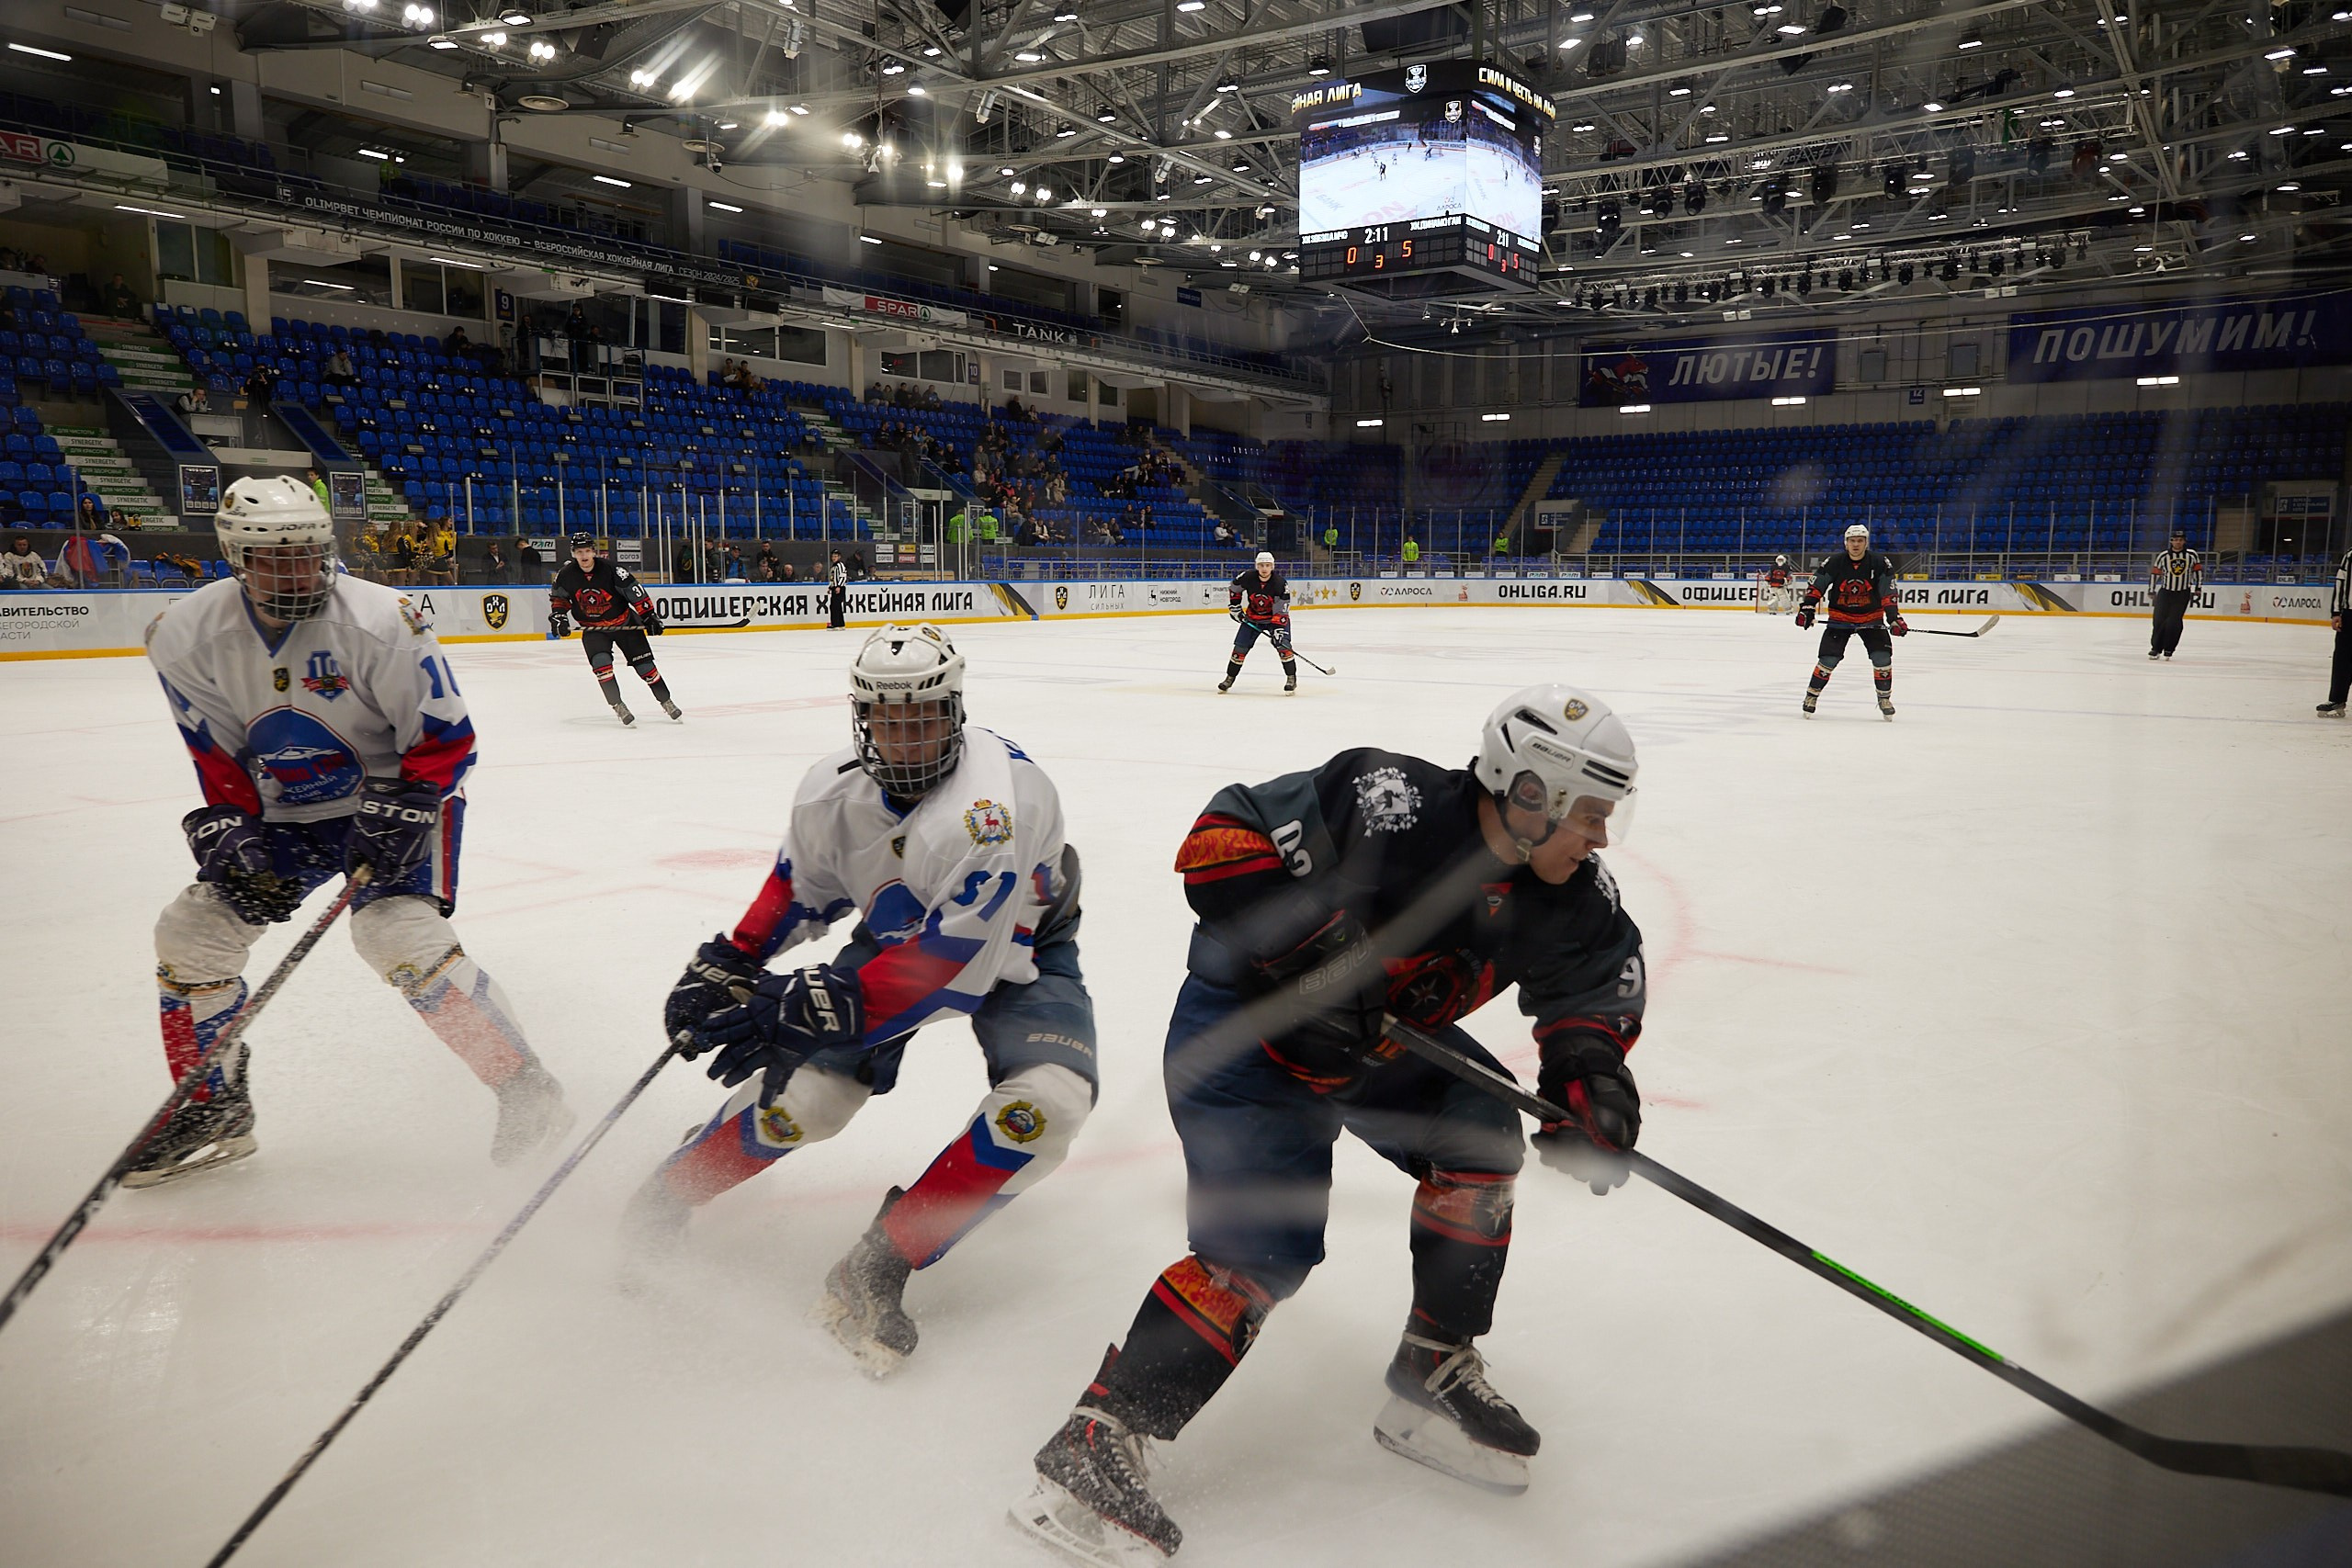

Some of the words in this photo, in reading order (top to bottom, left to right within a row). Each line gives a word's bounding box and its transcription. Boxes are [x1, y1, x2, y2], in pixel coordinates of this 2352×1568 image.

[1327, 82, 1363, 104] ЛИГА
[1478, 67, 1505, 89] СИЛА
[1505, 77, 1512, 92] И
[1512, 84, 1532, 106] ЧЕСТЬ
[1533, 95, 1544, 111] НА
[305, 197, 360, 216] OLIMPBET
[362, 209, 424, 230] ЧЕМПИОНАТ
[426, 220, 465, 237] РОССИИ
[467, 228, 481, 239] ПО
[483, 231, 521, 246] ХОККЕЮ
[534, 240, 605, 261] ВСЕРОССИЙСКАЯ
[606, 252, 653, 270] ХОККЕЙНАЯ
[654, 262, 674, 274] ЛИГА
[679, 266, 703, 278] СЕЗОН
[1364, 226, 1389, 244] 2:11
[1347, 246, 1358, 265] 0
[1401, 240, 1413, 258] 5
[1488, 243, 1495, 261] 0
[1374, 254, 1385, 269] 3
[1500, 258, 1507, 273] 3
[1512, 253, 1520, 269] 5
[502, 295, 510, 310] 9
[876, 300, 919, 318] SPAR
[1012, 323, 1066, 344] TANK
[2032, 310, 2317, 364] ПОШУМИМ!
[969, 365, 978, 377] 10
[1668, 346, 1824, 387] ЛЮТЫЕ!
[71, 438, 103, 446] SYNERGETIC
[531, 540, 554, 548] PARI
[1089, 584, 1125, 599] ЛИГА
[1498, 584, 1587, 599] OHLIGA.RU
[1937, 589, 1989, 604] ЛИГА
[656, 594, 808, 621] ОФИЦЕРСКАЯ
[816, 587, 924, 615] ХККЕЙНАЯ
[932, 591, 974, 612] ЛИГА
[1091, 603, 1125, 611] СИЛЬНЫХ
[876, 681, 912, 690] Reebok
[1532, 742, 1572, 762] BAUER
[1025, 1032, 1094, 1059] BAUER
